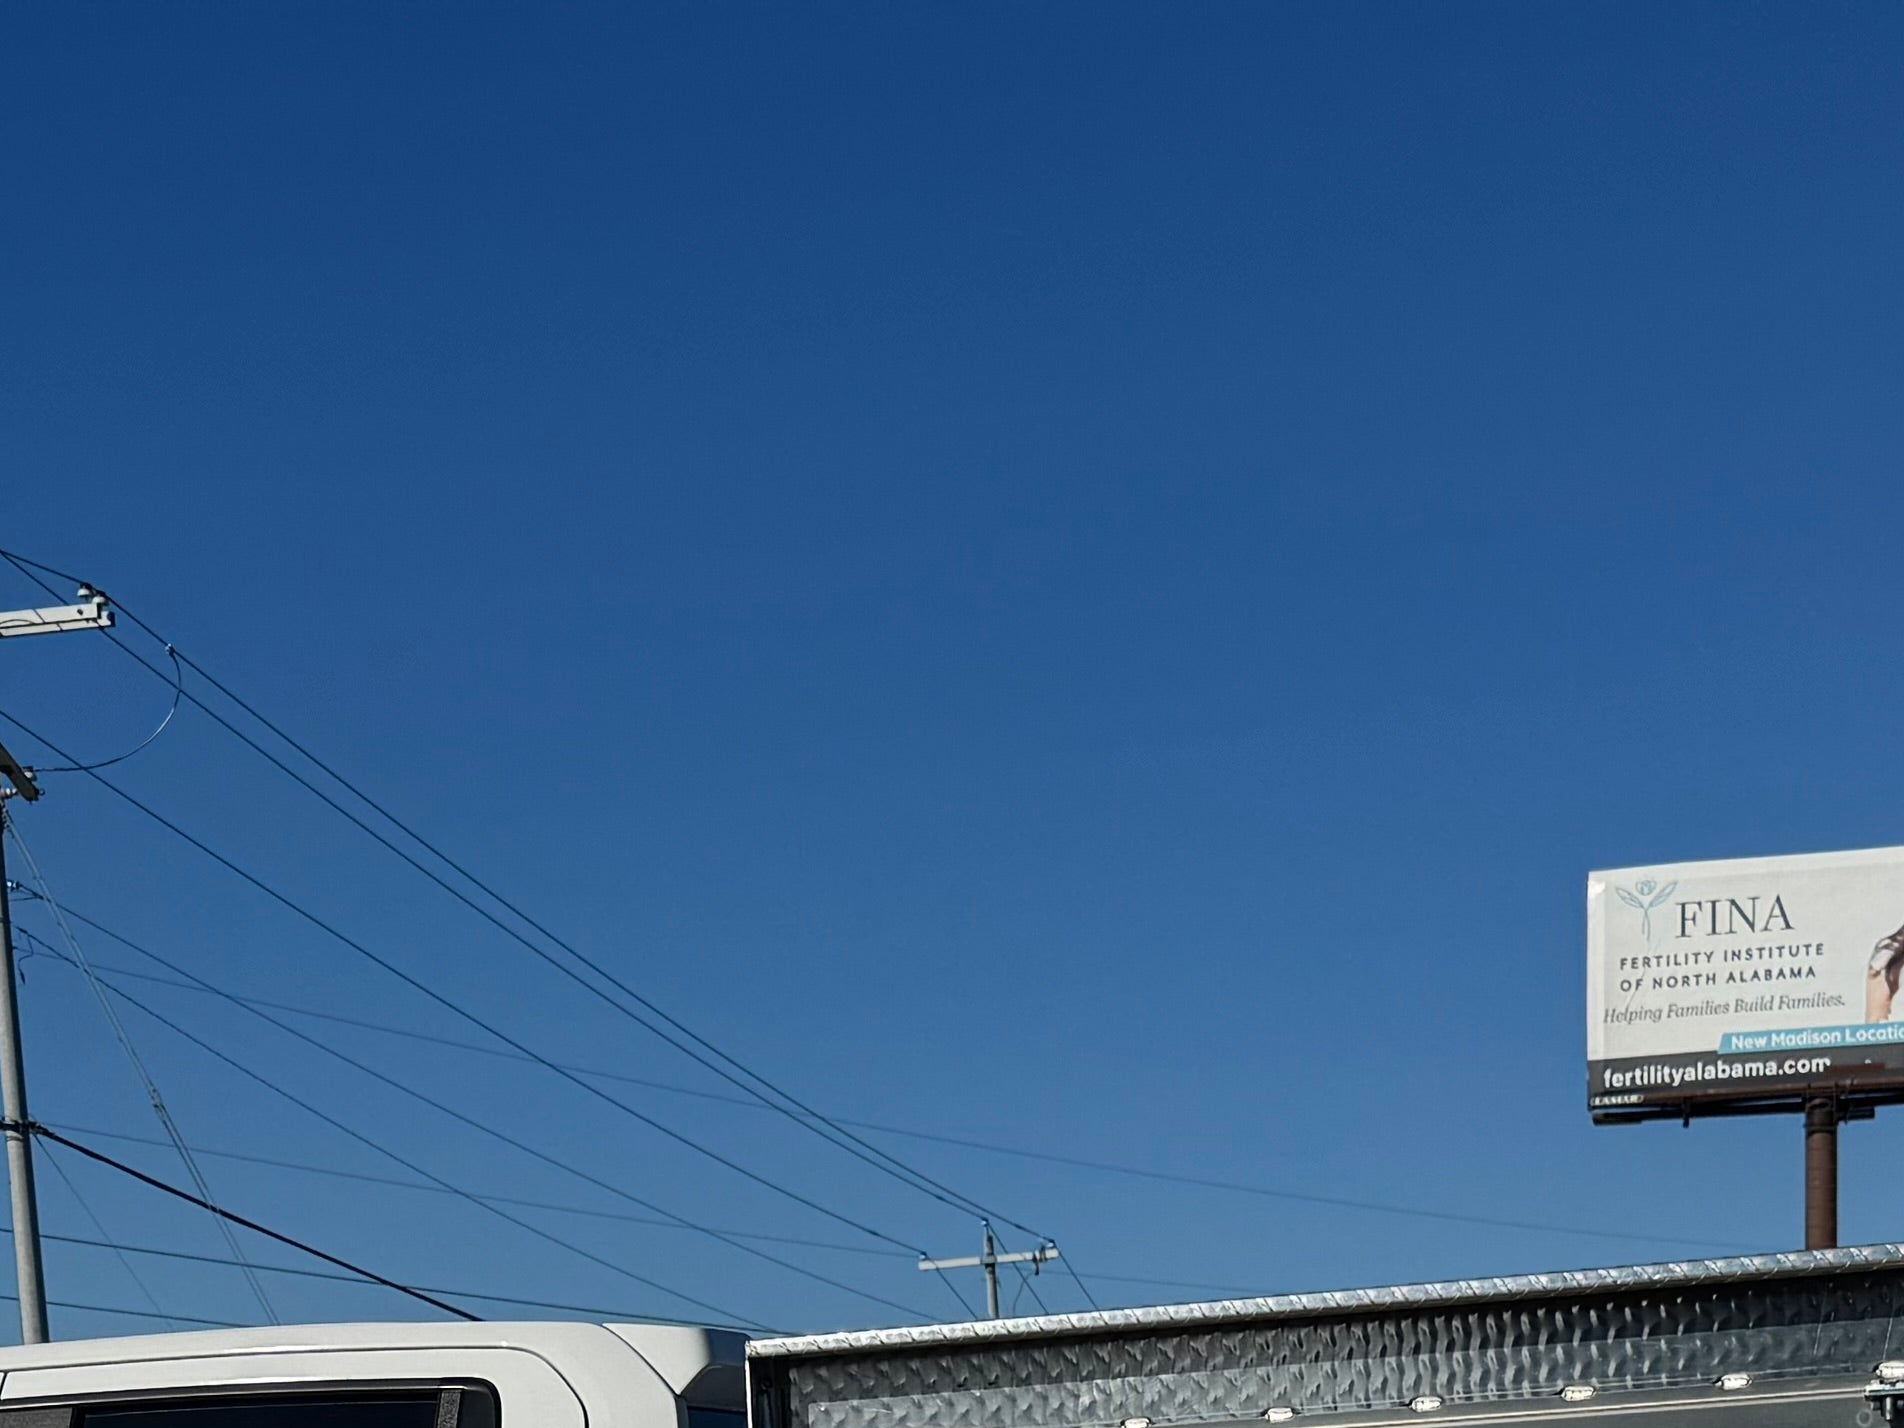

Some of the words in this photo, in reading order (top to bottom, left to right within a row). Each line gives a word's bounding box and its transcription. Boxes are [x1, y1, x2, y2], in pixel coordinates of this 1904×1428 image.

[1675, 894, 1795, 939] FINA
[1620, 951, 1714, 971] FERTILITY
[1723, 943, 1824, 963] INSTITUTE
[1620, 978, 1644, 992] OF
[1652, 972, 1716, 990] NORTH
[1726, 966, 1816, 984] ALABAMA
[1603, 1007, 1663, 1025] Helping
[1666, 1002, 1730, 1019] Families
[1734, 995, 1774, 1014] Build
[1731, 1034, 1768, 1050] New
[1771, 1030, 1842, 1048] Madison
[1604, 1056, 1831, 1088] fertilityalabama.com
